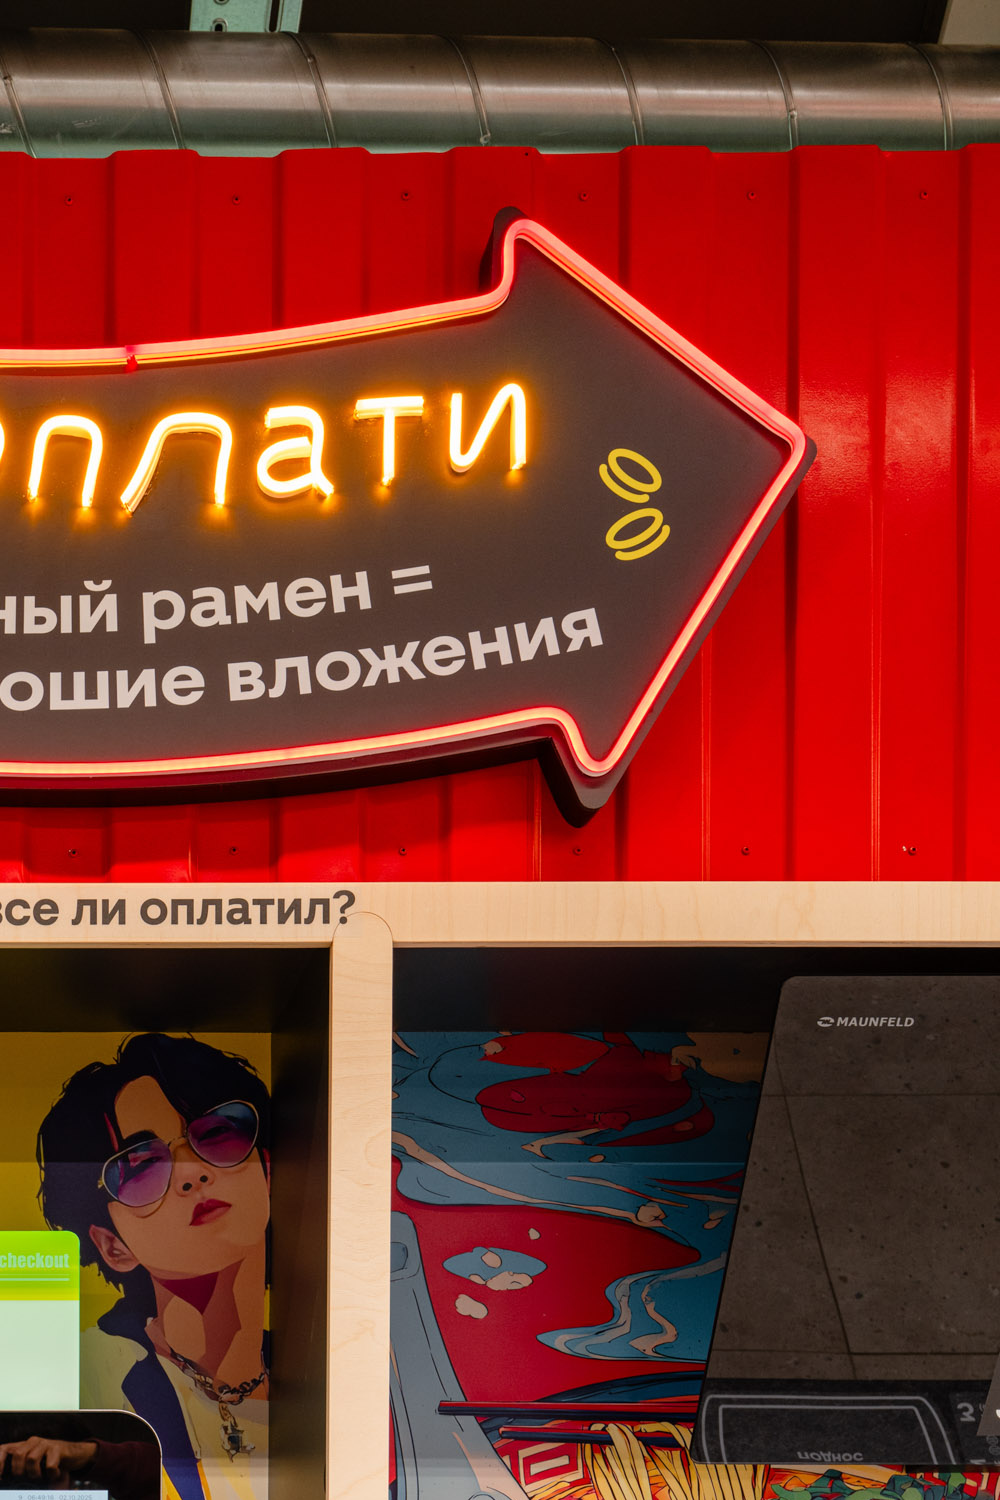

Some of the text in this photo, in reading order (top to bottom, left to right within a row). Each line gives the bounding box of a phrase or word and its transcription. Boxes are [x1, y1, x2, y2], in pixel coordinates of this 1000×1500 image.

[142, 569, 373, 644] рамен
[227, 606, 604, 705] вложения
[71, 894, 132, 928] ли
[140, 890, 358, 930] оплатил?
[836, 1016, 915, 1028] MAUNFELD
